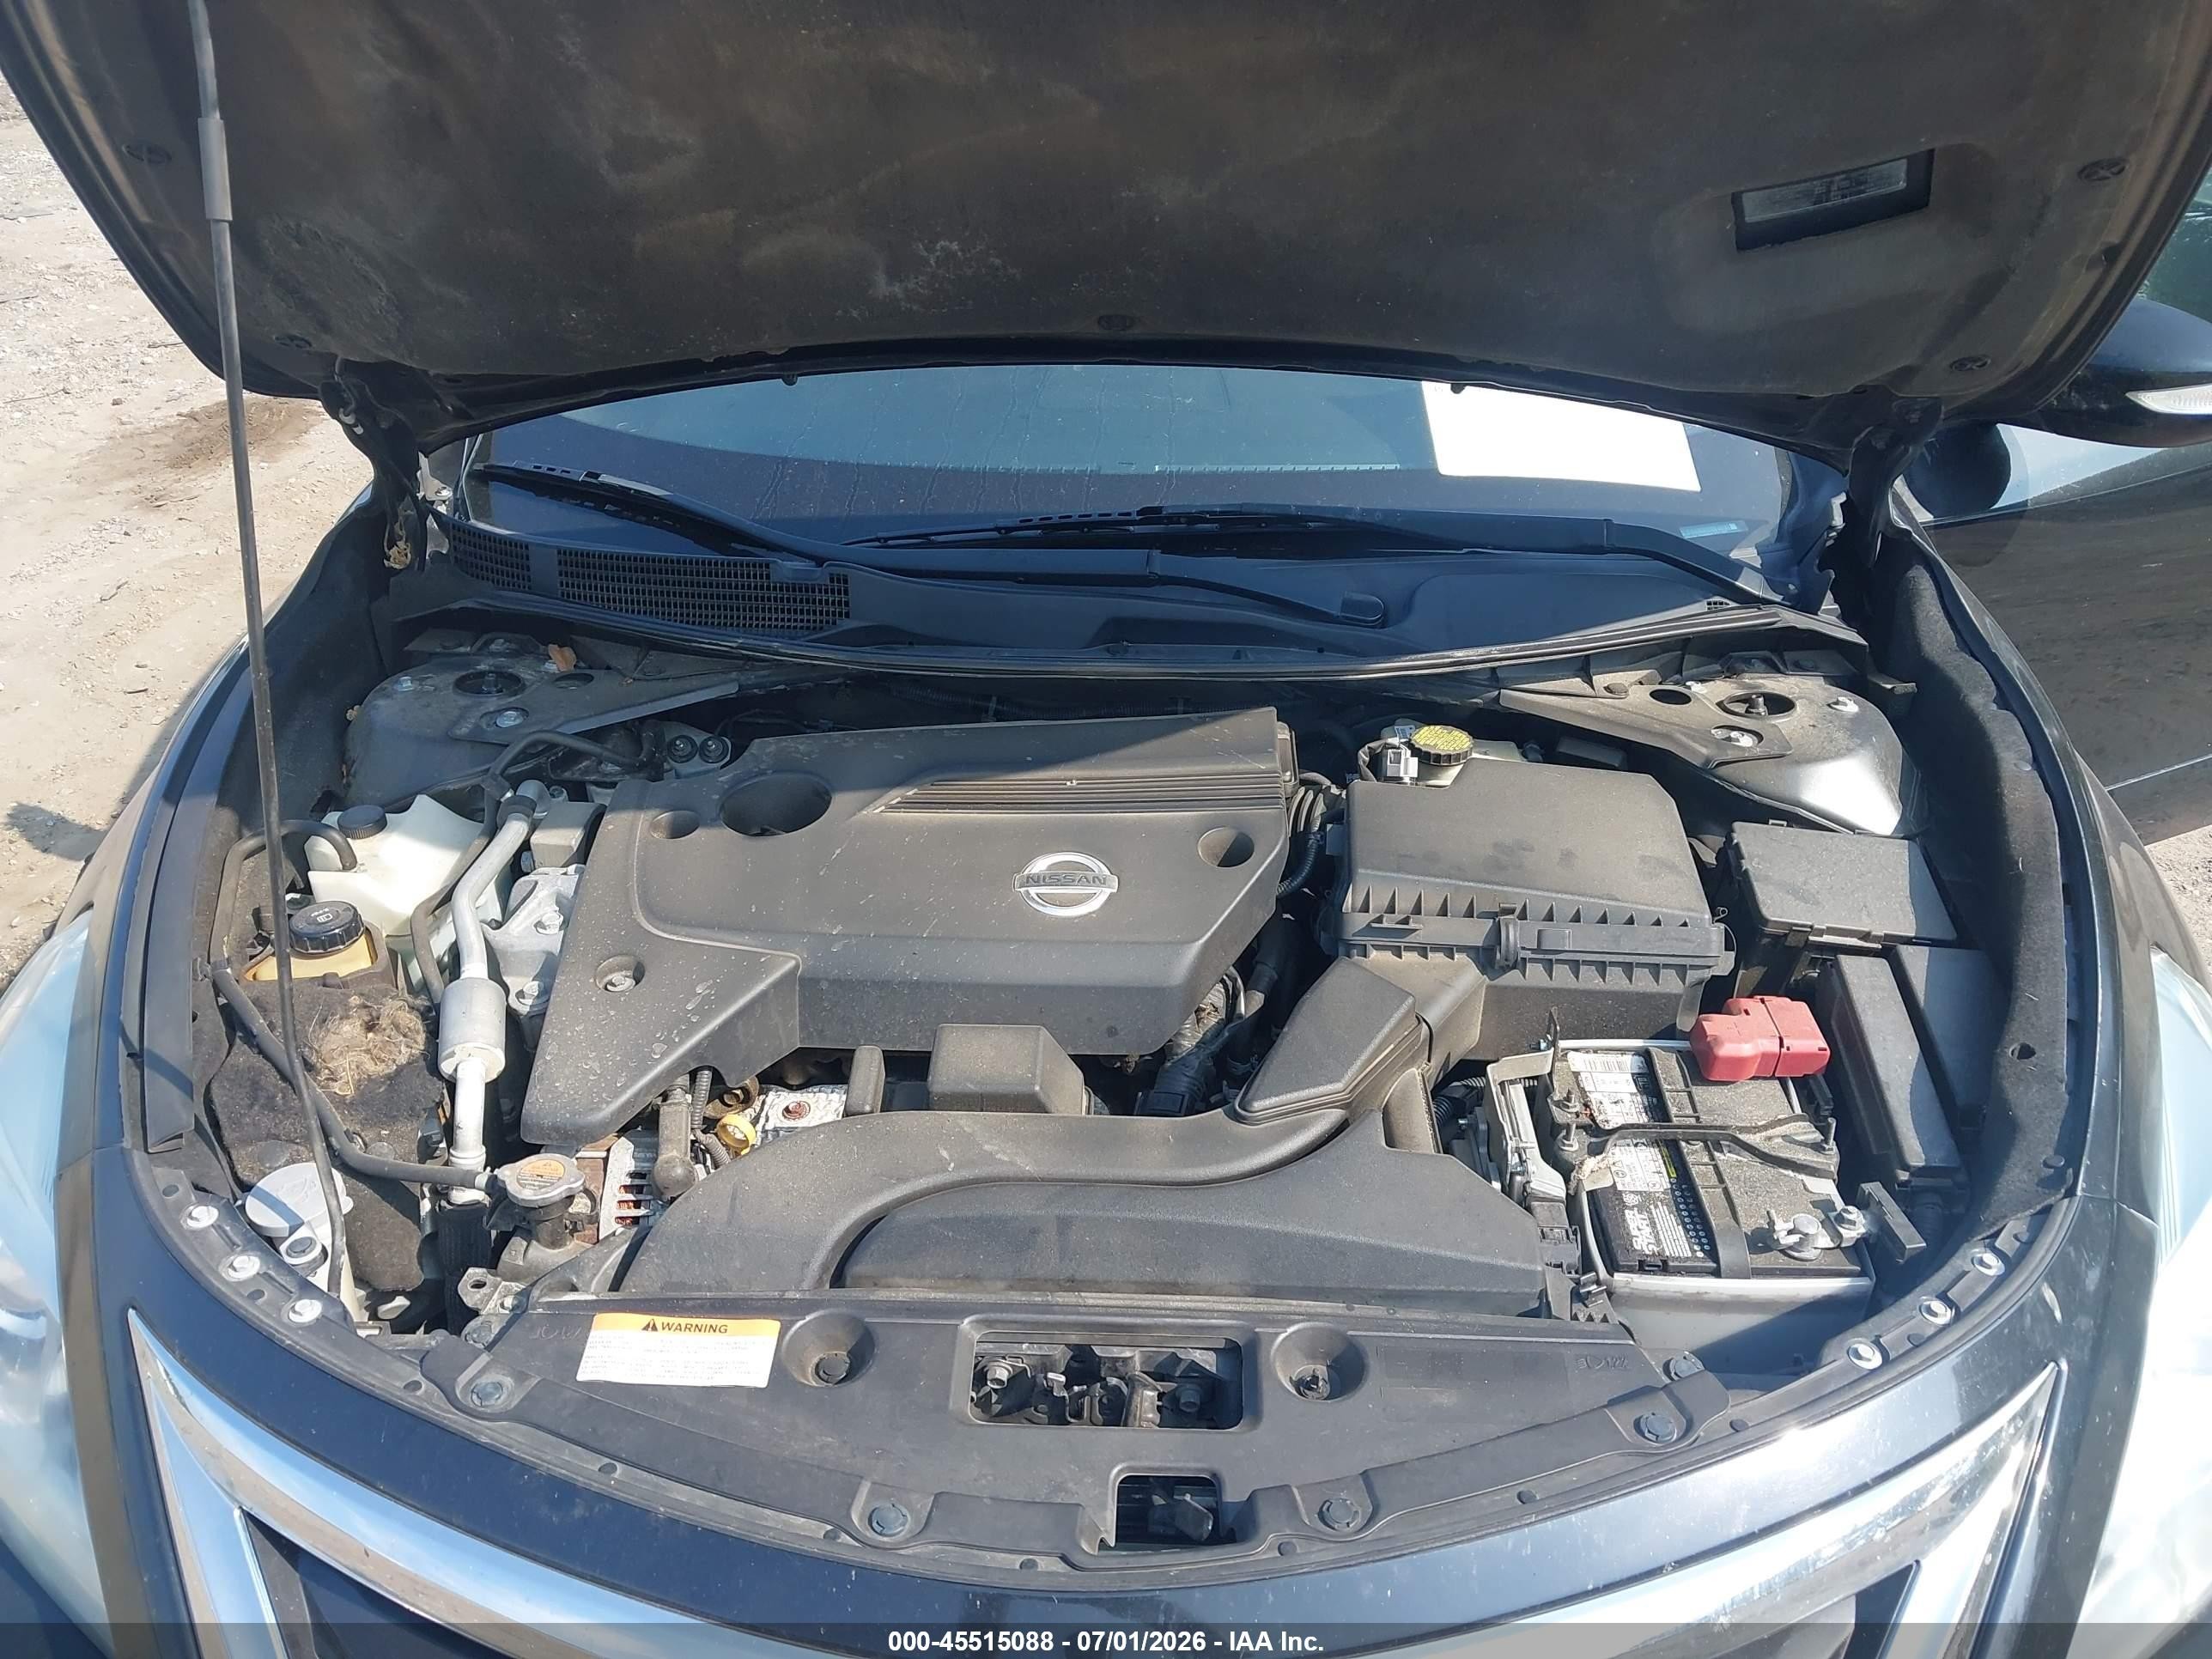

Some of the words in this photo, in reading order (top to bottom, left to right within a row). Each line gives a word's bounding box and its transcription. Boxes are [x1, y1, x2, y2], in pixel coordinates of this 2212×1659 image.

[1025, 874, 1107, 885] NISSAN
[1624, 1209, 1643, 1250] SUPER
[660, 1322, 728, 1334] WARNING
